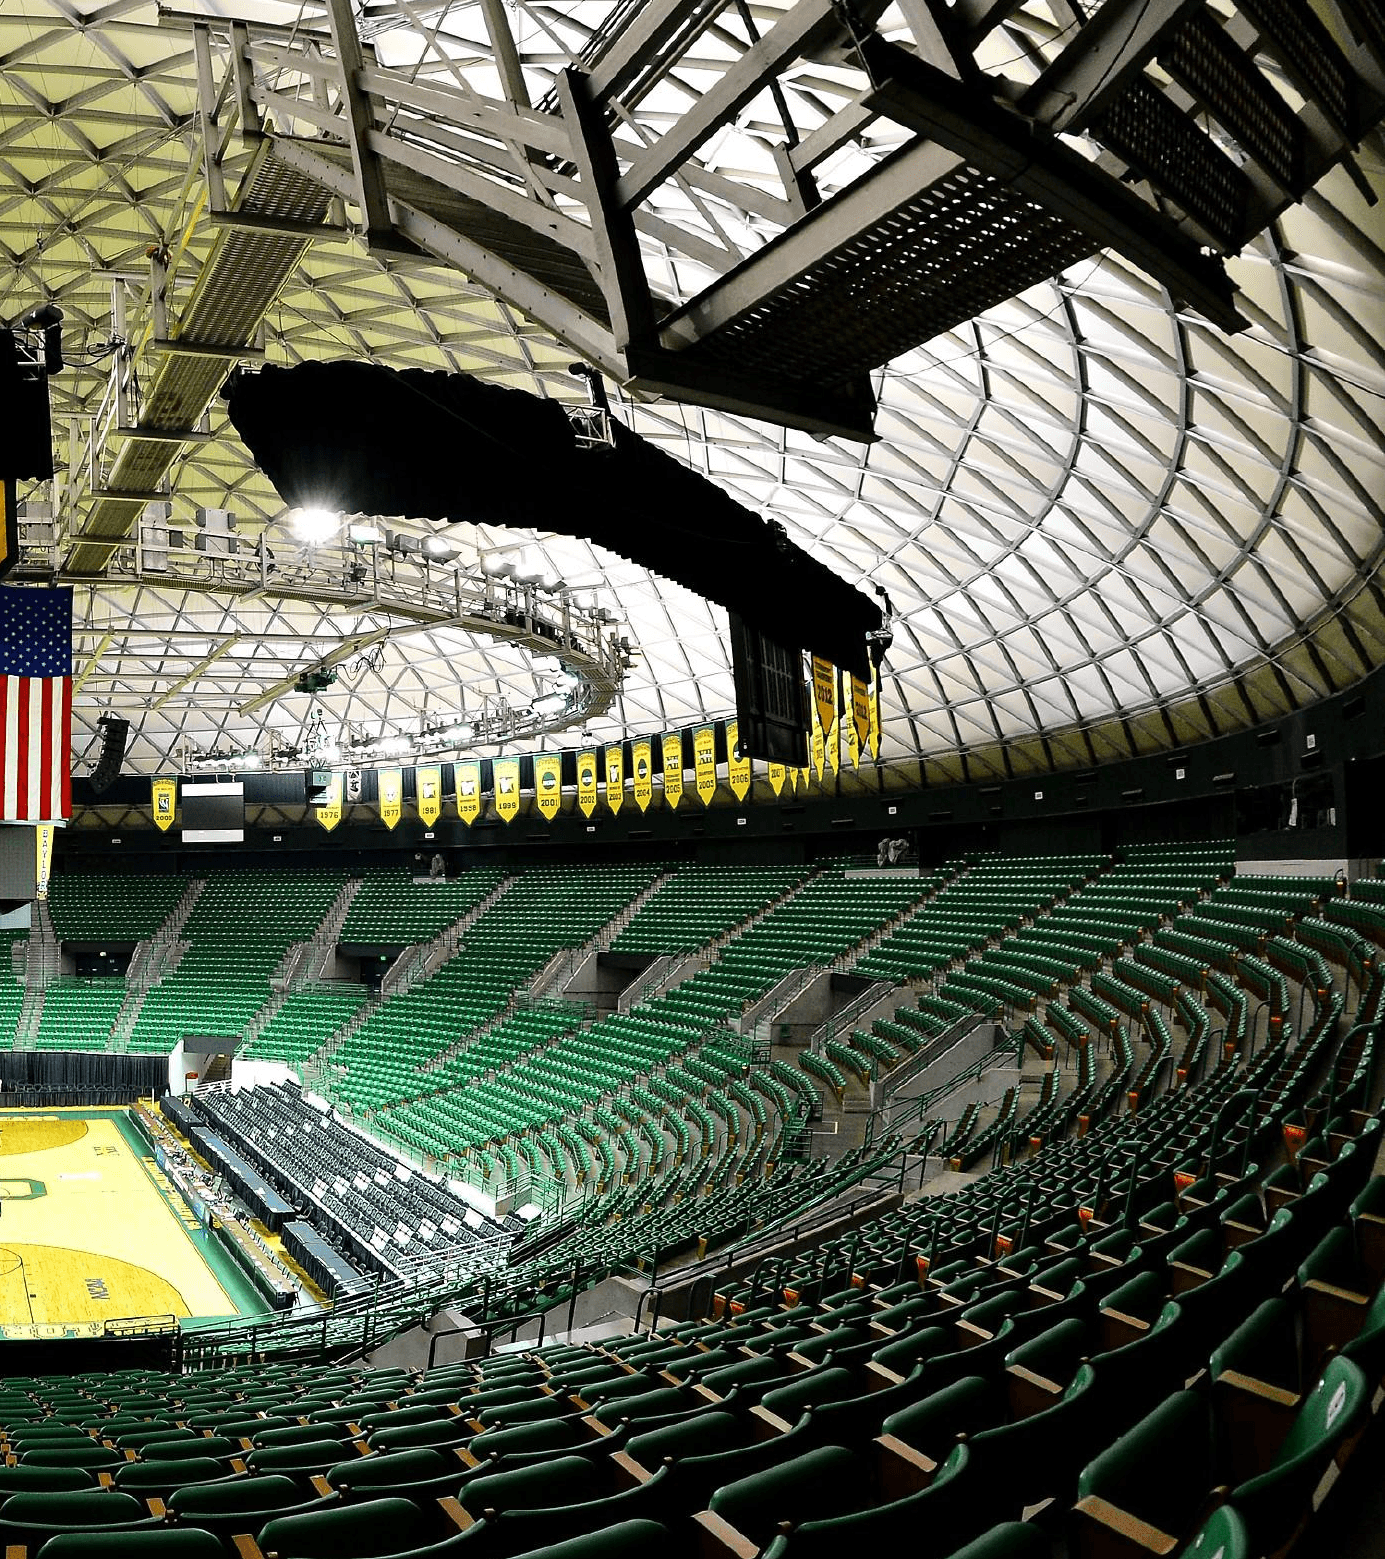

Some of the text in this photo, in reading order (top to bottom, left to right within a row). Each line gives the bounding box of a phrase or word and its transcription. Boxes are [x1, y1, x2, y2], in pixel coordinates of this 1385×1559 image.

[541, 798, 558, 807] 2001
[384, 809, 399, 817] 1977
[40, 829, 50, 890] BAYLOR
